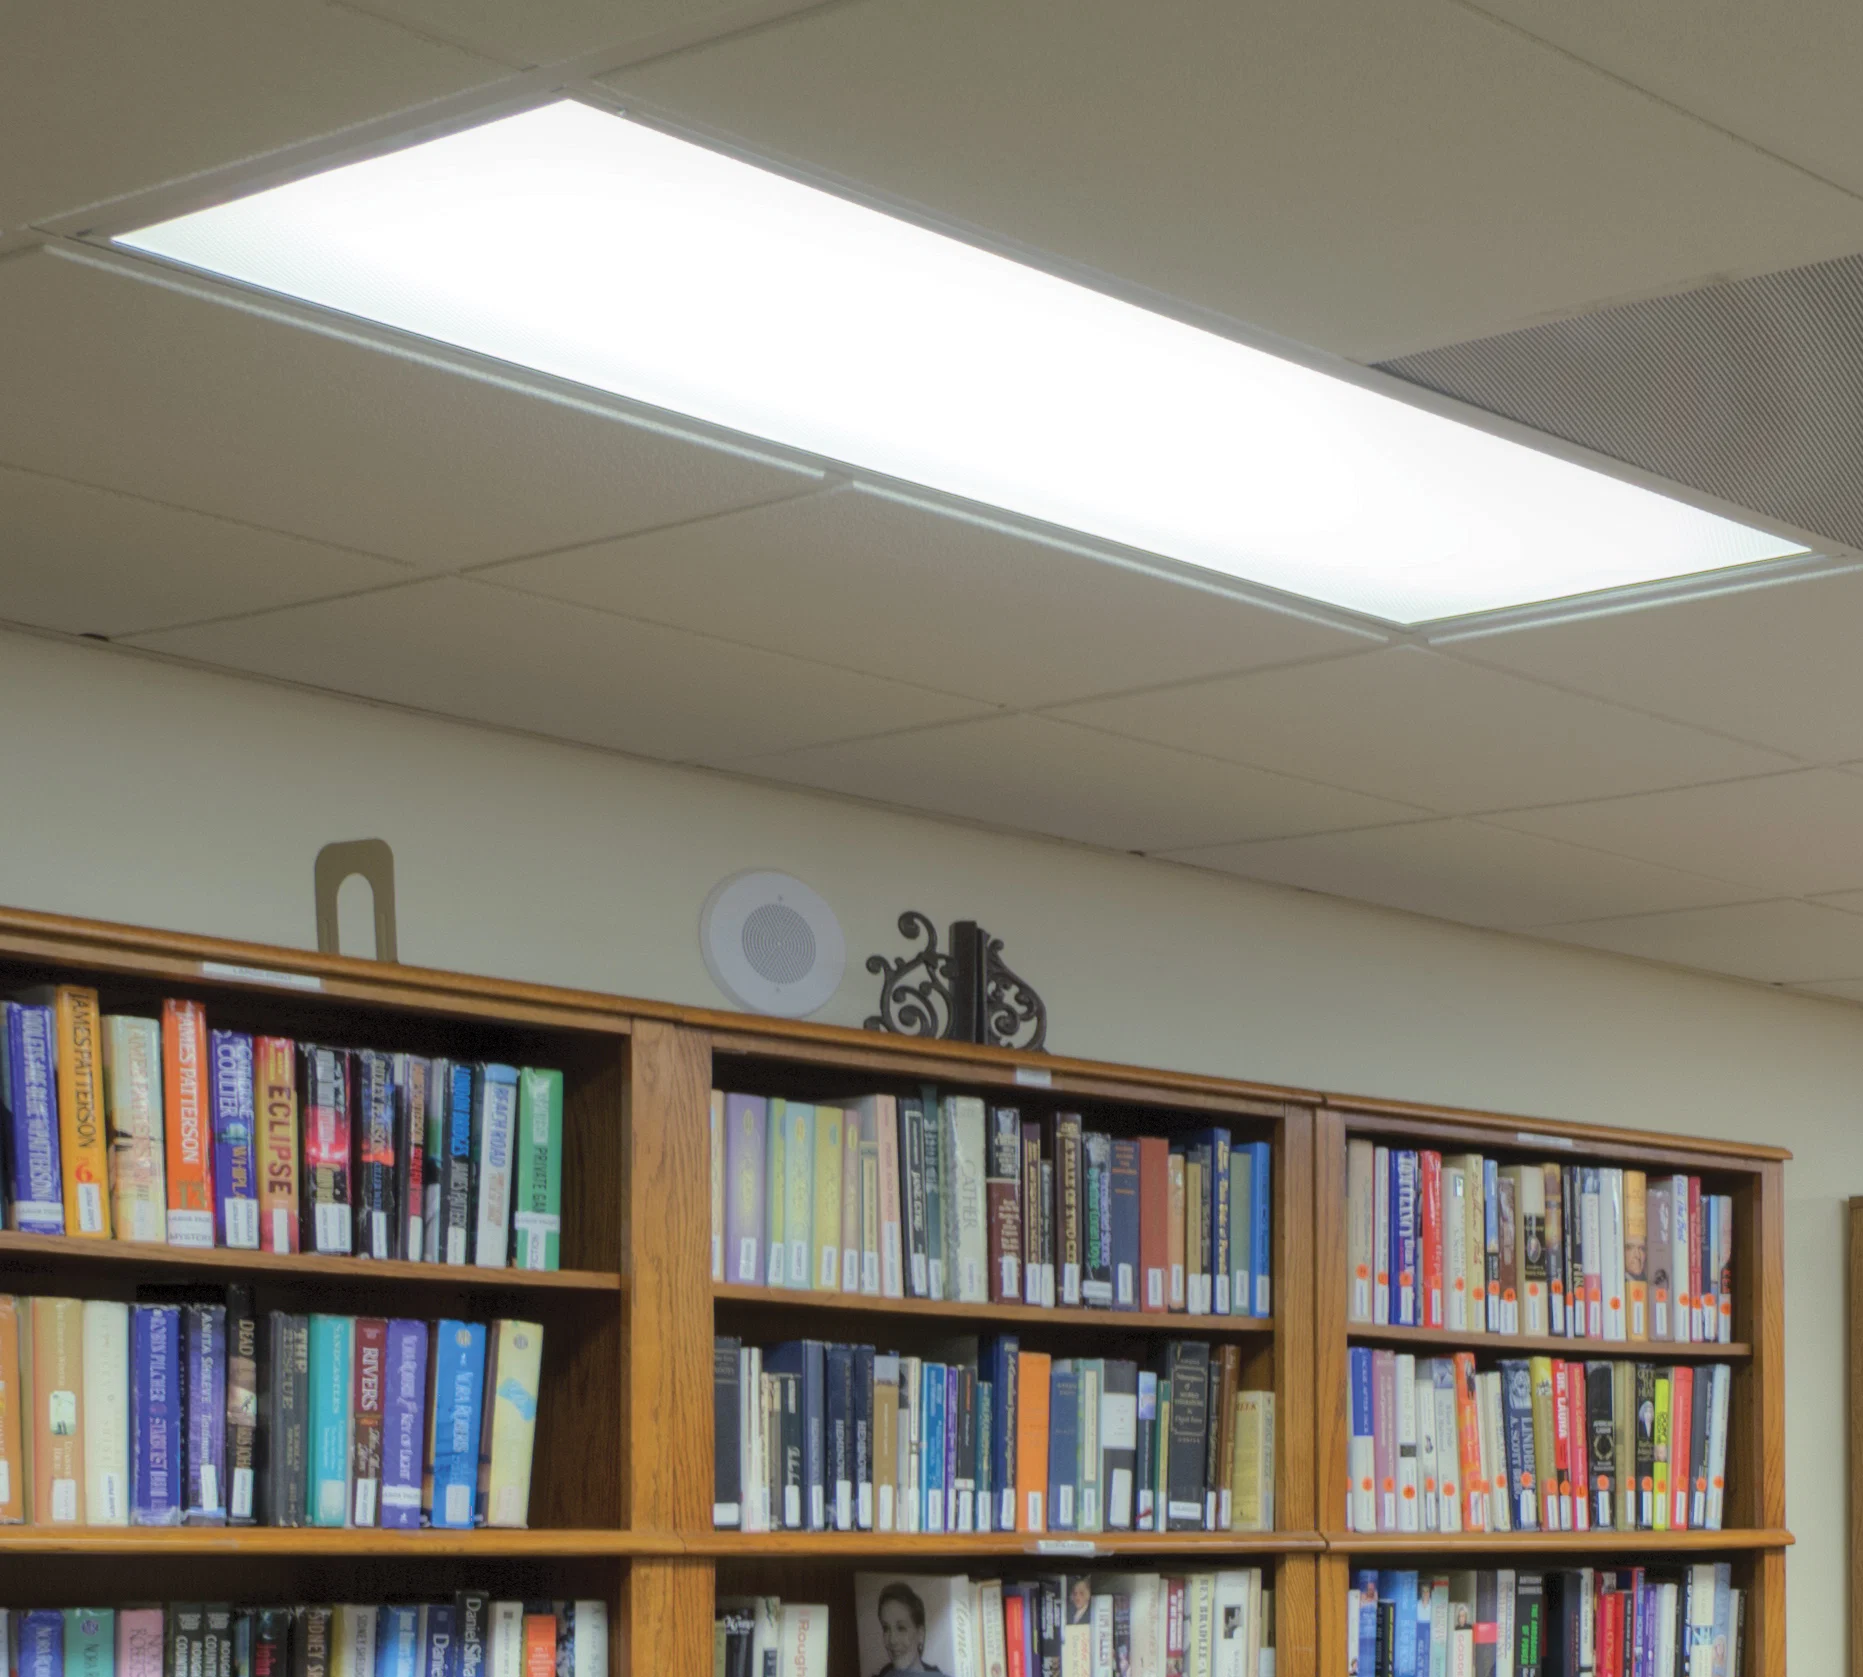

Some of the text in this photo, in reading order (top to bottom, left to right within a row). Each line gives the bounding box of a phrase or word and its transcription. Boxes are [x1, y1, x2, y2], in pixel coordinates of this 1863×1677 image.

[68, 992, 96, 1148] JAMES PATTERSON
[178, 1012, 199, 1164] JAMES PATTERSON
[218, 1044, 237, 1118] COULTER
[268, 1085, 291, 1194] ECLIPSE
[489, 1088, 509, 1167] BEACH ROAD
[532, 1147, 548, 1189] PRIVATE
[960, 1160, 978, 1230] CATHER
[201, 1312, 213, 1402] ANITA SHREVE
[239, 1320, 254, 1355] DEAD
[332, 1325, 343, 1414] SANDCASTLES
[361, 1347, 379, 1410] RIVERS
[454, 1372, 472, 1452] NORA ROBERTS
[306, 1609, 324, 1659] SIDNEY
[465, 1598, 480, 1642] Daniel
[220, 1641, 230, 1677] ROUGH
[256, 1644, 276, 1675] John
